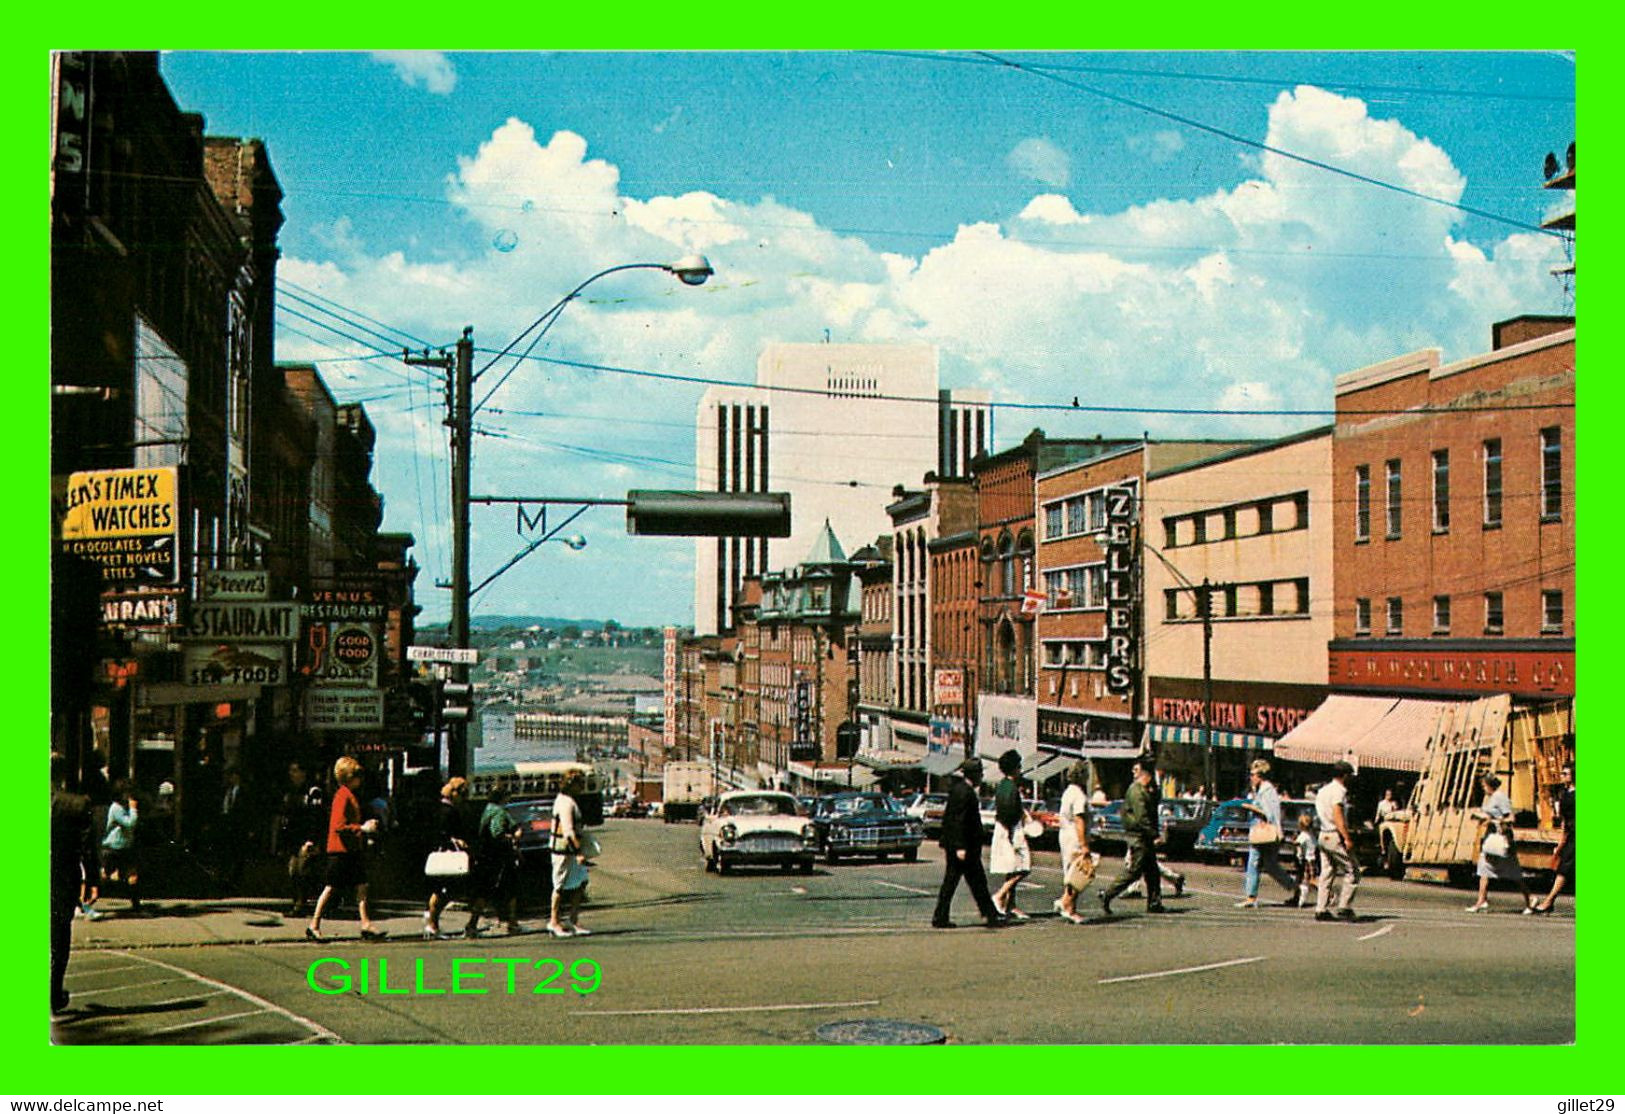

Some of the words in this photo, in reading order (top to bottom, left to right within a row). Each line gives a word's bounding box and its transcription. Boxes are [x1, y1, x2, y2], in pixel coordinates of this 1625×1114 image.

[105, 474, 158, 500] TIMEX
[92, 504, 171, 530] WATCHES
[517, 501, 546, 535] M
[73, 539, 142, 554] CHOCOLATES
[126, 551, 171, 565] NOVELS
[312, 591, 374, 603] VENUS
[300, 605, 384, 619] RESTAURANT
[179, 608, 292, 637] ESTAURANT
[338, 636, 369, 646] GOOD
[338, 648, 369, 659] FOOD
[412, 649, 455, 659] CHARLOTTE
[191, 669, 221, 685] SEA
[233, 668, 278, 684] FOOD
[1388, 659, 1518, 685] WOOLWORTH
[1153, 698, 1246, 728] METROPOLITAN
